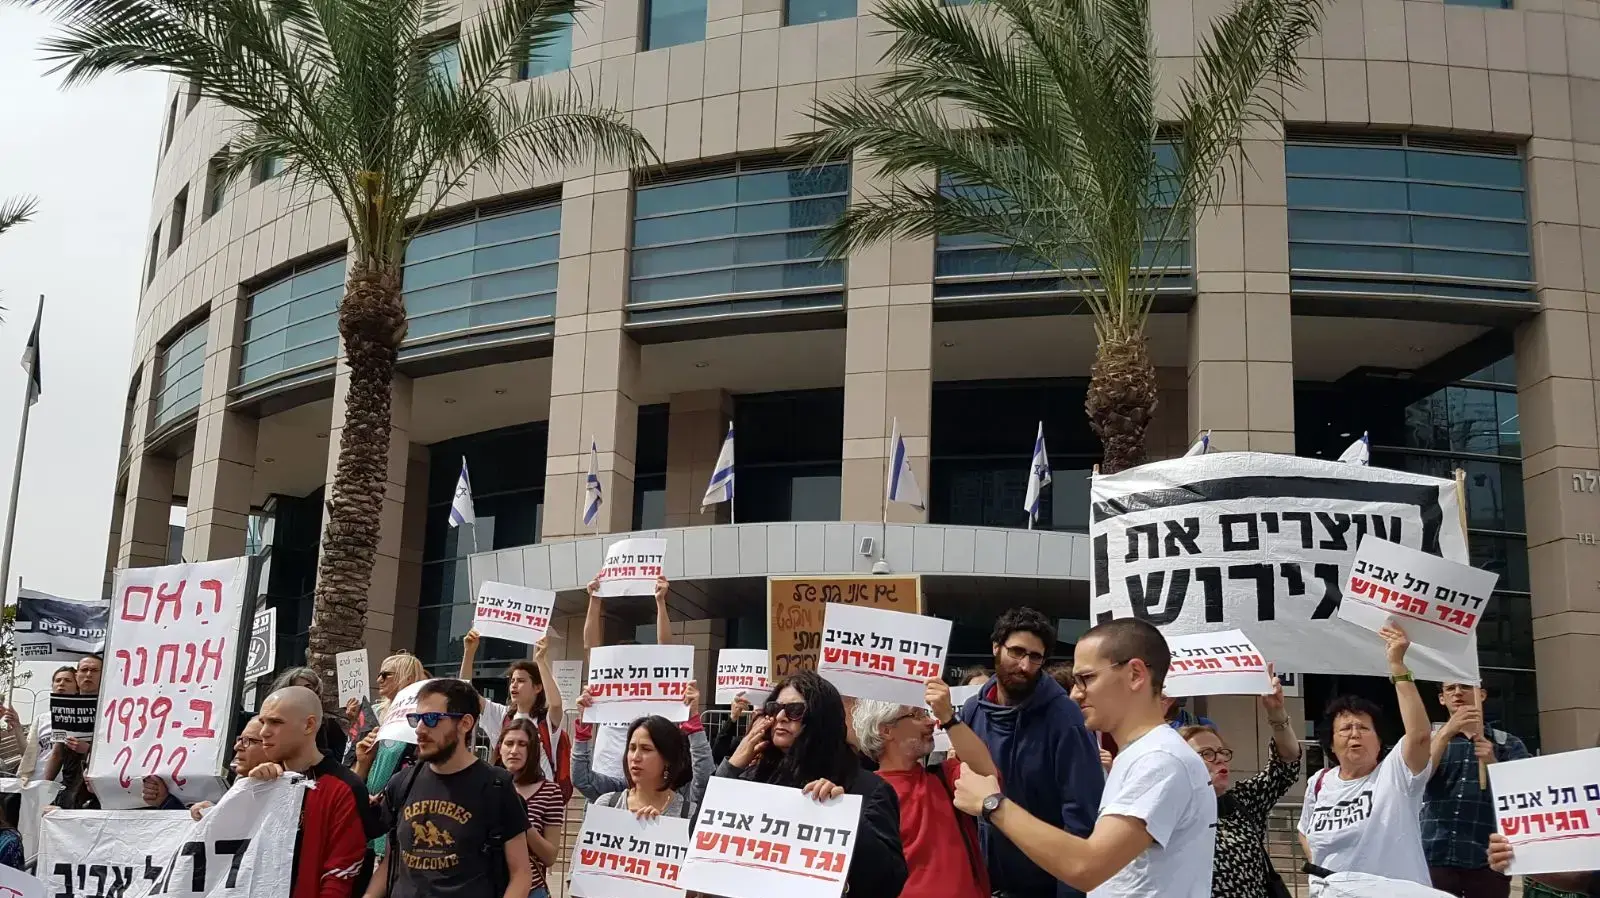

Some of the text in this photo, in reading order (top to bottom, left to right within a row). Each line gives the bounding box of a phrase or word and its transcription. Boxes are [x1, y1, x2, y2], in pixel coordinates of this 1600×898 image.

[1125, 511, 1402, 563] עוצרים את
[622, 553, 634, 563] תל
[637, 554, 663, 563] דרום
[598, 566, 662, 578] נגד הגירוש
[793, 583, 817, 602] של
[1125, 561, 1343, 627] גירוש
[1354, 560, 1484, 610] דרום תל אביב
[479, 596, 550, 616] דרום תל אביב
[1350, 576, 1477, 629] נגד הגירוש
[477, 606, 548, 628] נגד הגירוש
[825, 629, 944, 659] דרום תל אביב
[1181, 647, 1208, 657] תל
[1210, 643, 1253, 655] דרום
[590, 664, 690, 680] דרום תל אביב
[718, 662, 767, 674] ום תל אביב
[823, 646, 940, 678] נגד הגירוש
[1168, 654, 1264, 672] נגד הגיר
[590, 682, 652, 697] הגירוש
[717, 675, 754, 686] הגירוש
[1497, 790, 1543, 811] אביב
[1547, 785, 1578, 805] תל
[404, 800, 473, 825] REFUGEES
[1500, 809, 1589, 836] הגירוש
[700, 808, 852, 847] דרום תל אביב
[582, 830, 688, 860] דרום תל אביב
[695, 830, 847, 873] נגד הגירוש
[580, 848, 682, 881] גד הגירוש
